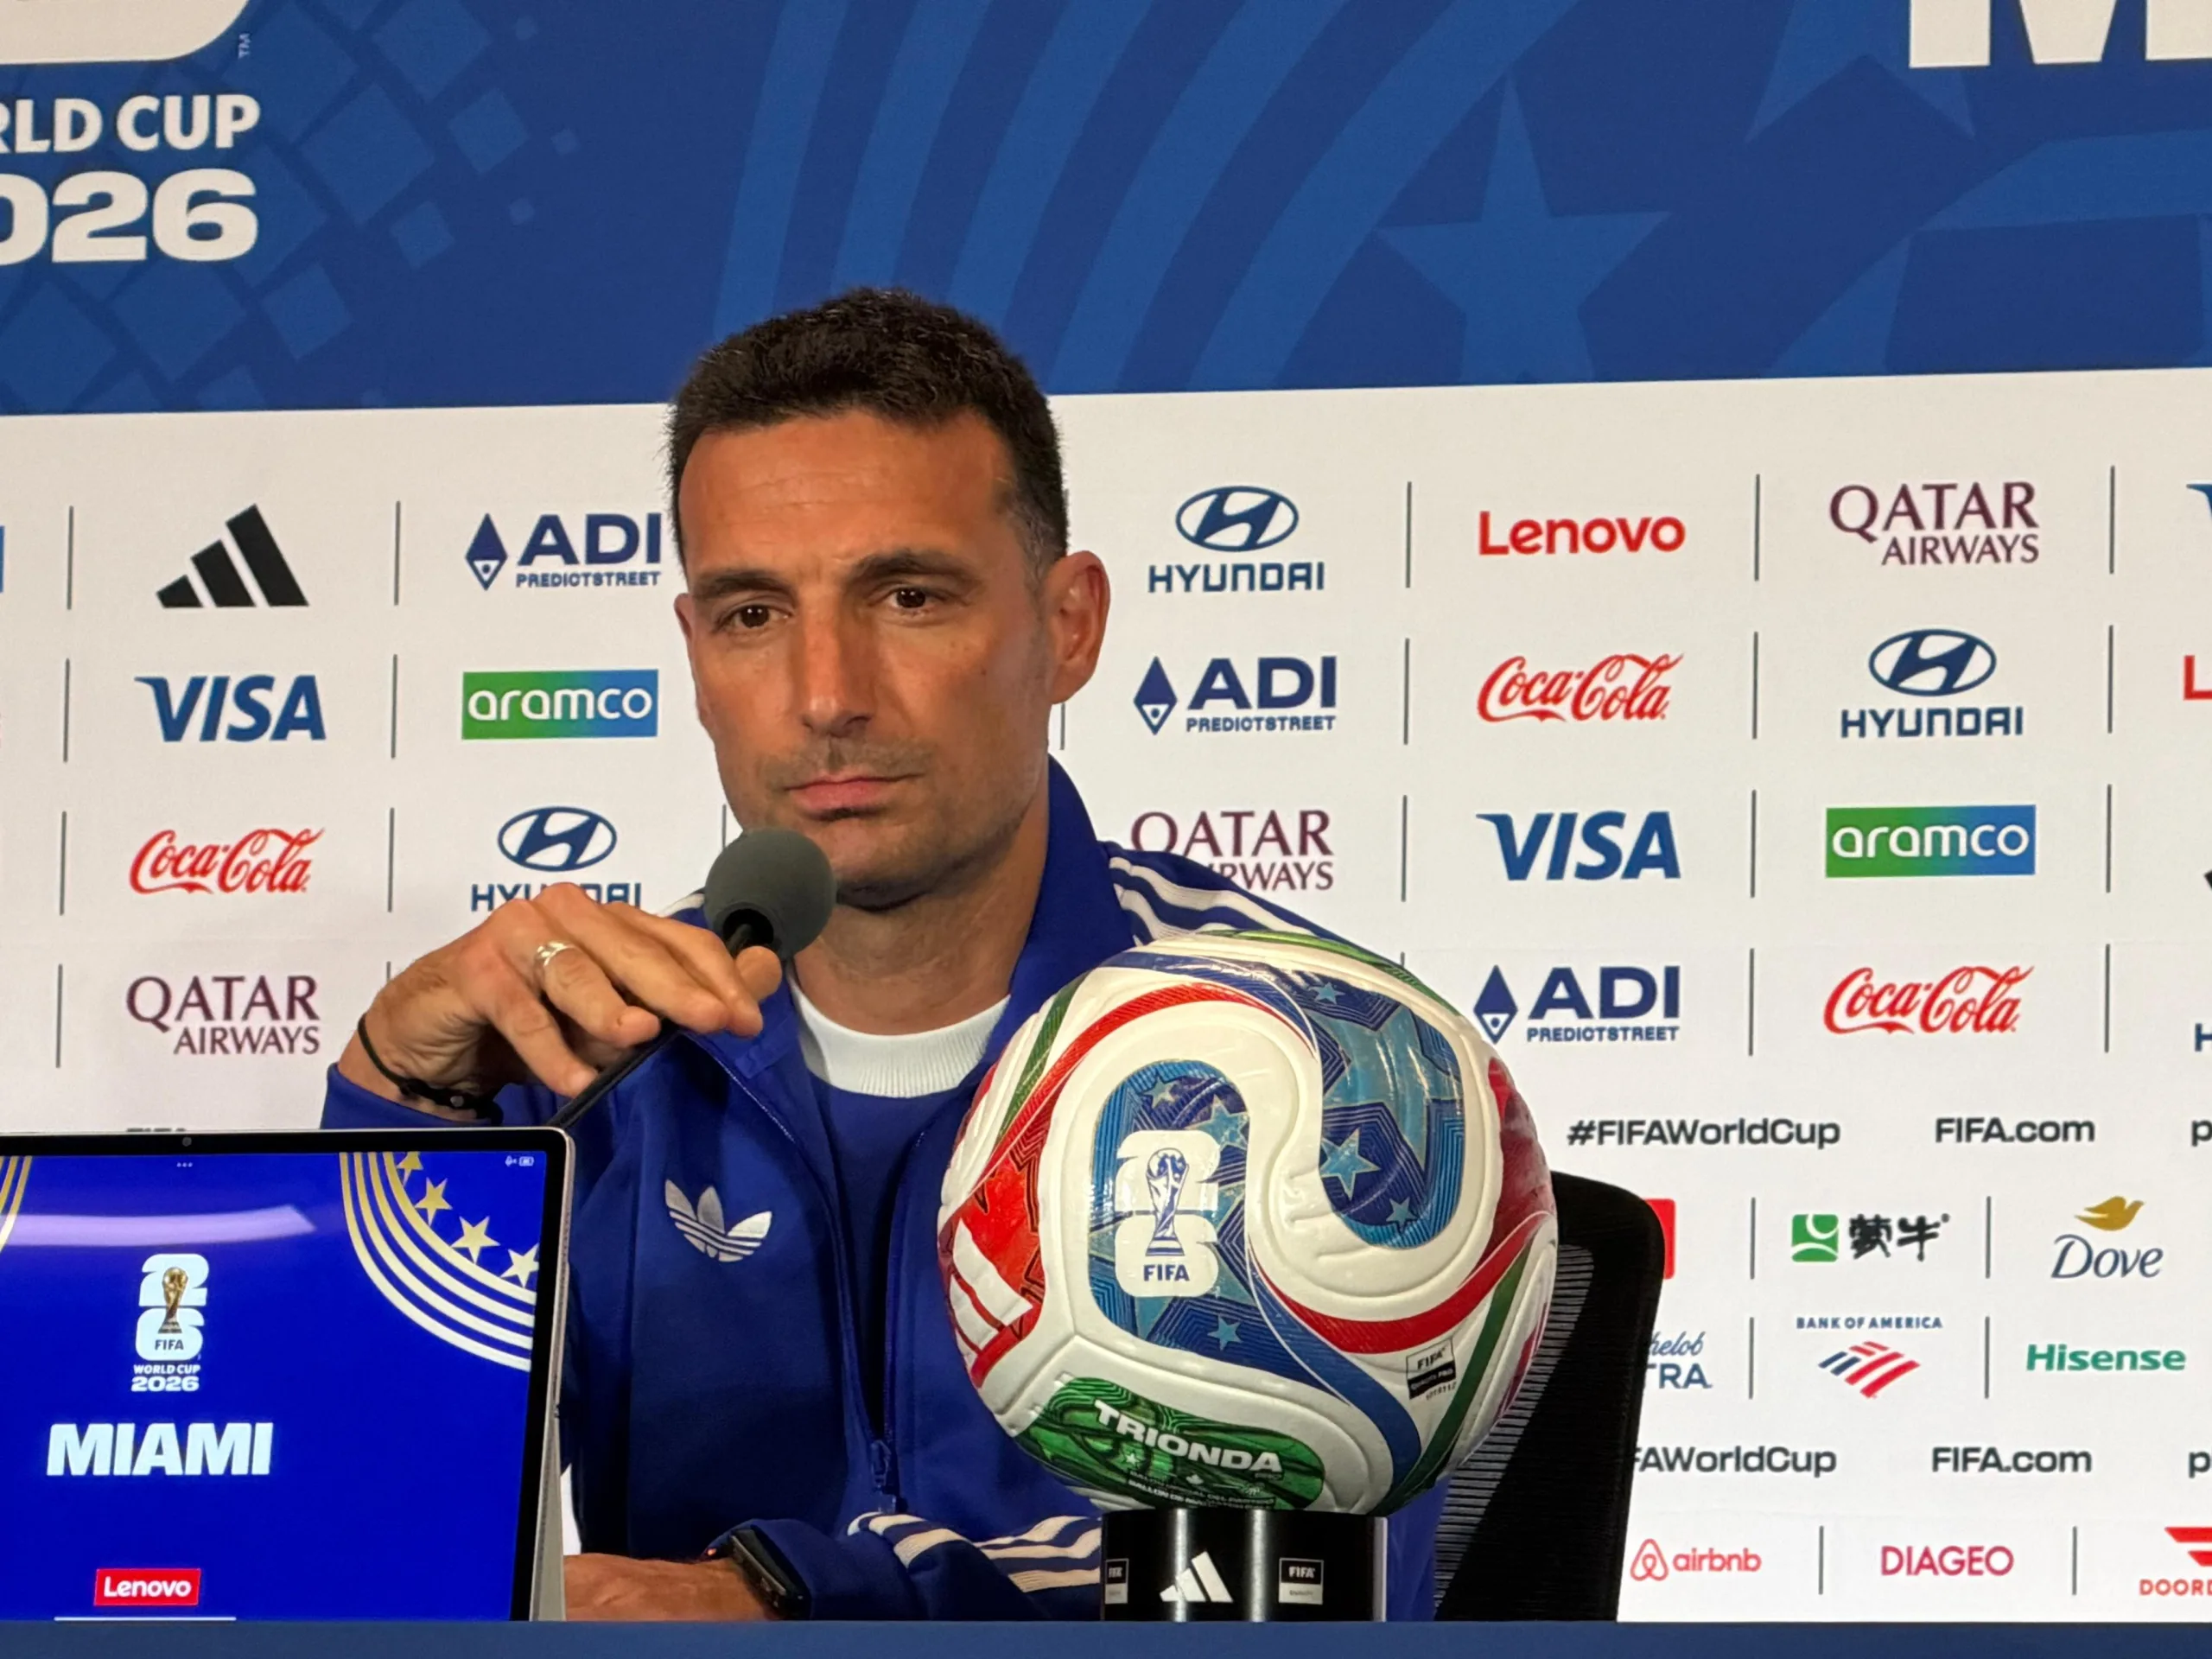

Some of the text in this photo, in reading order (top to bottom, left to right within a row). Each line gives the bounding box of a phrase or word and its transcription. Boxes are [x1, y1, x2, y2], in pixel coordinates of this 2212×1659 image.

[0, 95, 260, 153] LD CUP
[1830, 482, 2038, 543] QATAR
[518, 513, 661, 565] ADI
[1479, 512, 1685, 555] Lenovo
[1882, 534, 2038, 565] AIRWAYS
[516, 571, 660, 588] PREDICTSTREET
[1149, 562, 1324, 593] HYUNDAI
[1188, 656, 1337, 709] ADI
[135, 675, 326, 742] VISA
[468, 689, 652, 721] aramco
[1186, 715, 1336, 732] PREDICTSTREET
[1841, 707, 2023, 738] HYUNDAI
[1131, 810, 1333, 856] QATAR
[1476, 811, 1681, 880] VISA
[1833, 824, 2029, 858] aramco
[126, 976, 320, 1033] QATAR
[1529, 965, 1681, 1020] ADI
[174, 1027, 320, 1054] AIRWAYS
[1527, 1026, 1680, 1042] PREDICTSTREET
[1567, 1117, 1840, 1148] #FIFAWorldCup
[1936, 1117, 2095, 1143] FIFA.com
[2051, 1234, 2164, 1279] Dove
[1143, 1264, 1190, 1281] FIFA
[1796, 1316, 1942, 1330] BANK OF AMERICA
[155, 1339, 184, 1351] FIFA
[2026, 1344, 2186, 1371] Hisense
[131, 1376, 200, 1392] 2026
[133, 1363, 200, 1375] WORLD CUP
[47, 1422, 273, 1476] MIAMI
[1094, 1400, 1283, 1473] TRIONDA
[1636, 1446, 1836, 1478] AWorldCup
[1933, 1447, 2092, 1473] FIFA.com
[1289, 1566, 1316, 1578] FIFA
[1673, 1548, 1762, 1573] airbnb
[1881, 1546, 2014, 1577] DIAGEO
[104, 1577, 192, 1598] Lenovo
